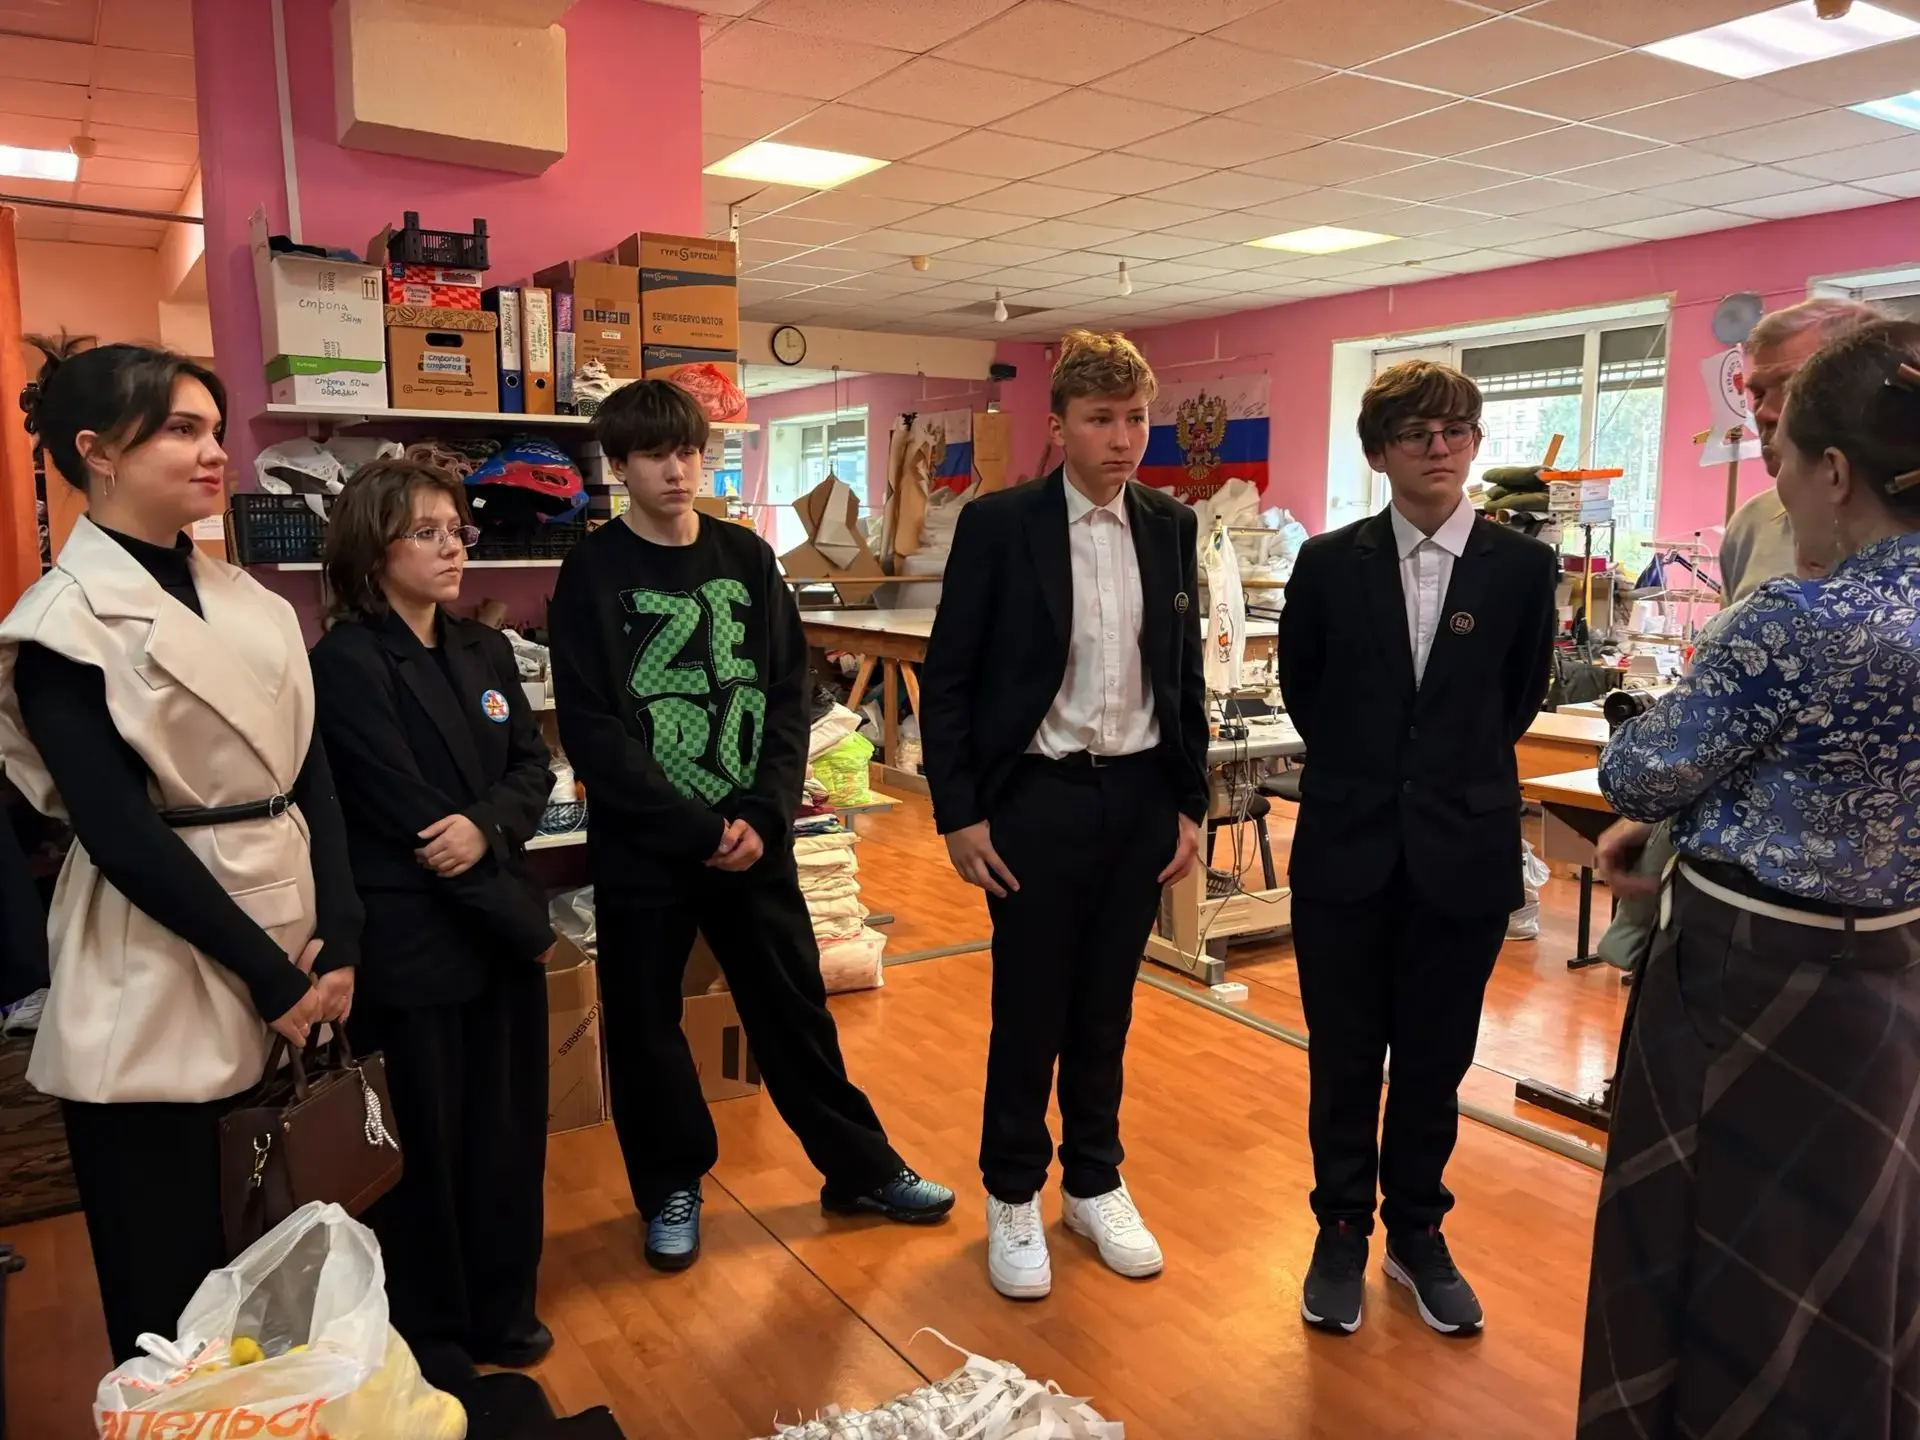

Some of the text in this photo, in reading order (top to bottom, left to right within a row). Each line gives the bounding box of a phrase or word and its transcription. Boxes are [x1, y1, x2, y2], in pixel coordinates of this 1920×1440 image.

[660, 248, 678, 257] TYPE
[689, 250, 718, 261] SPECIAL
[298, 297, 349, 314] стропа
[652, 312, 724, 326] SEWING SERVO MOTOR
